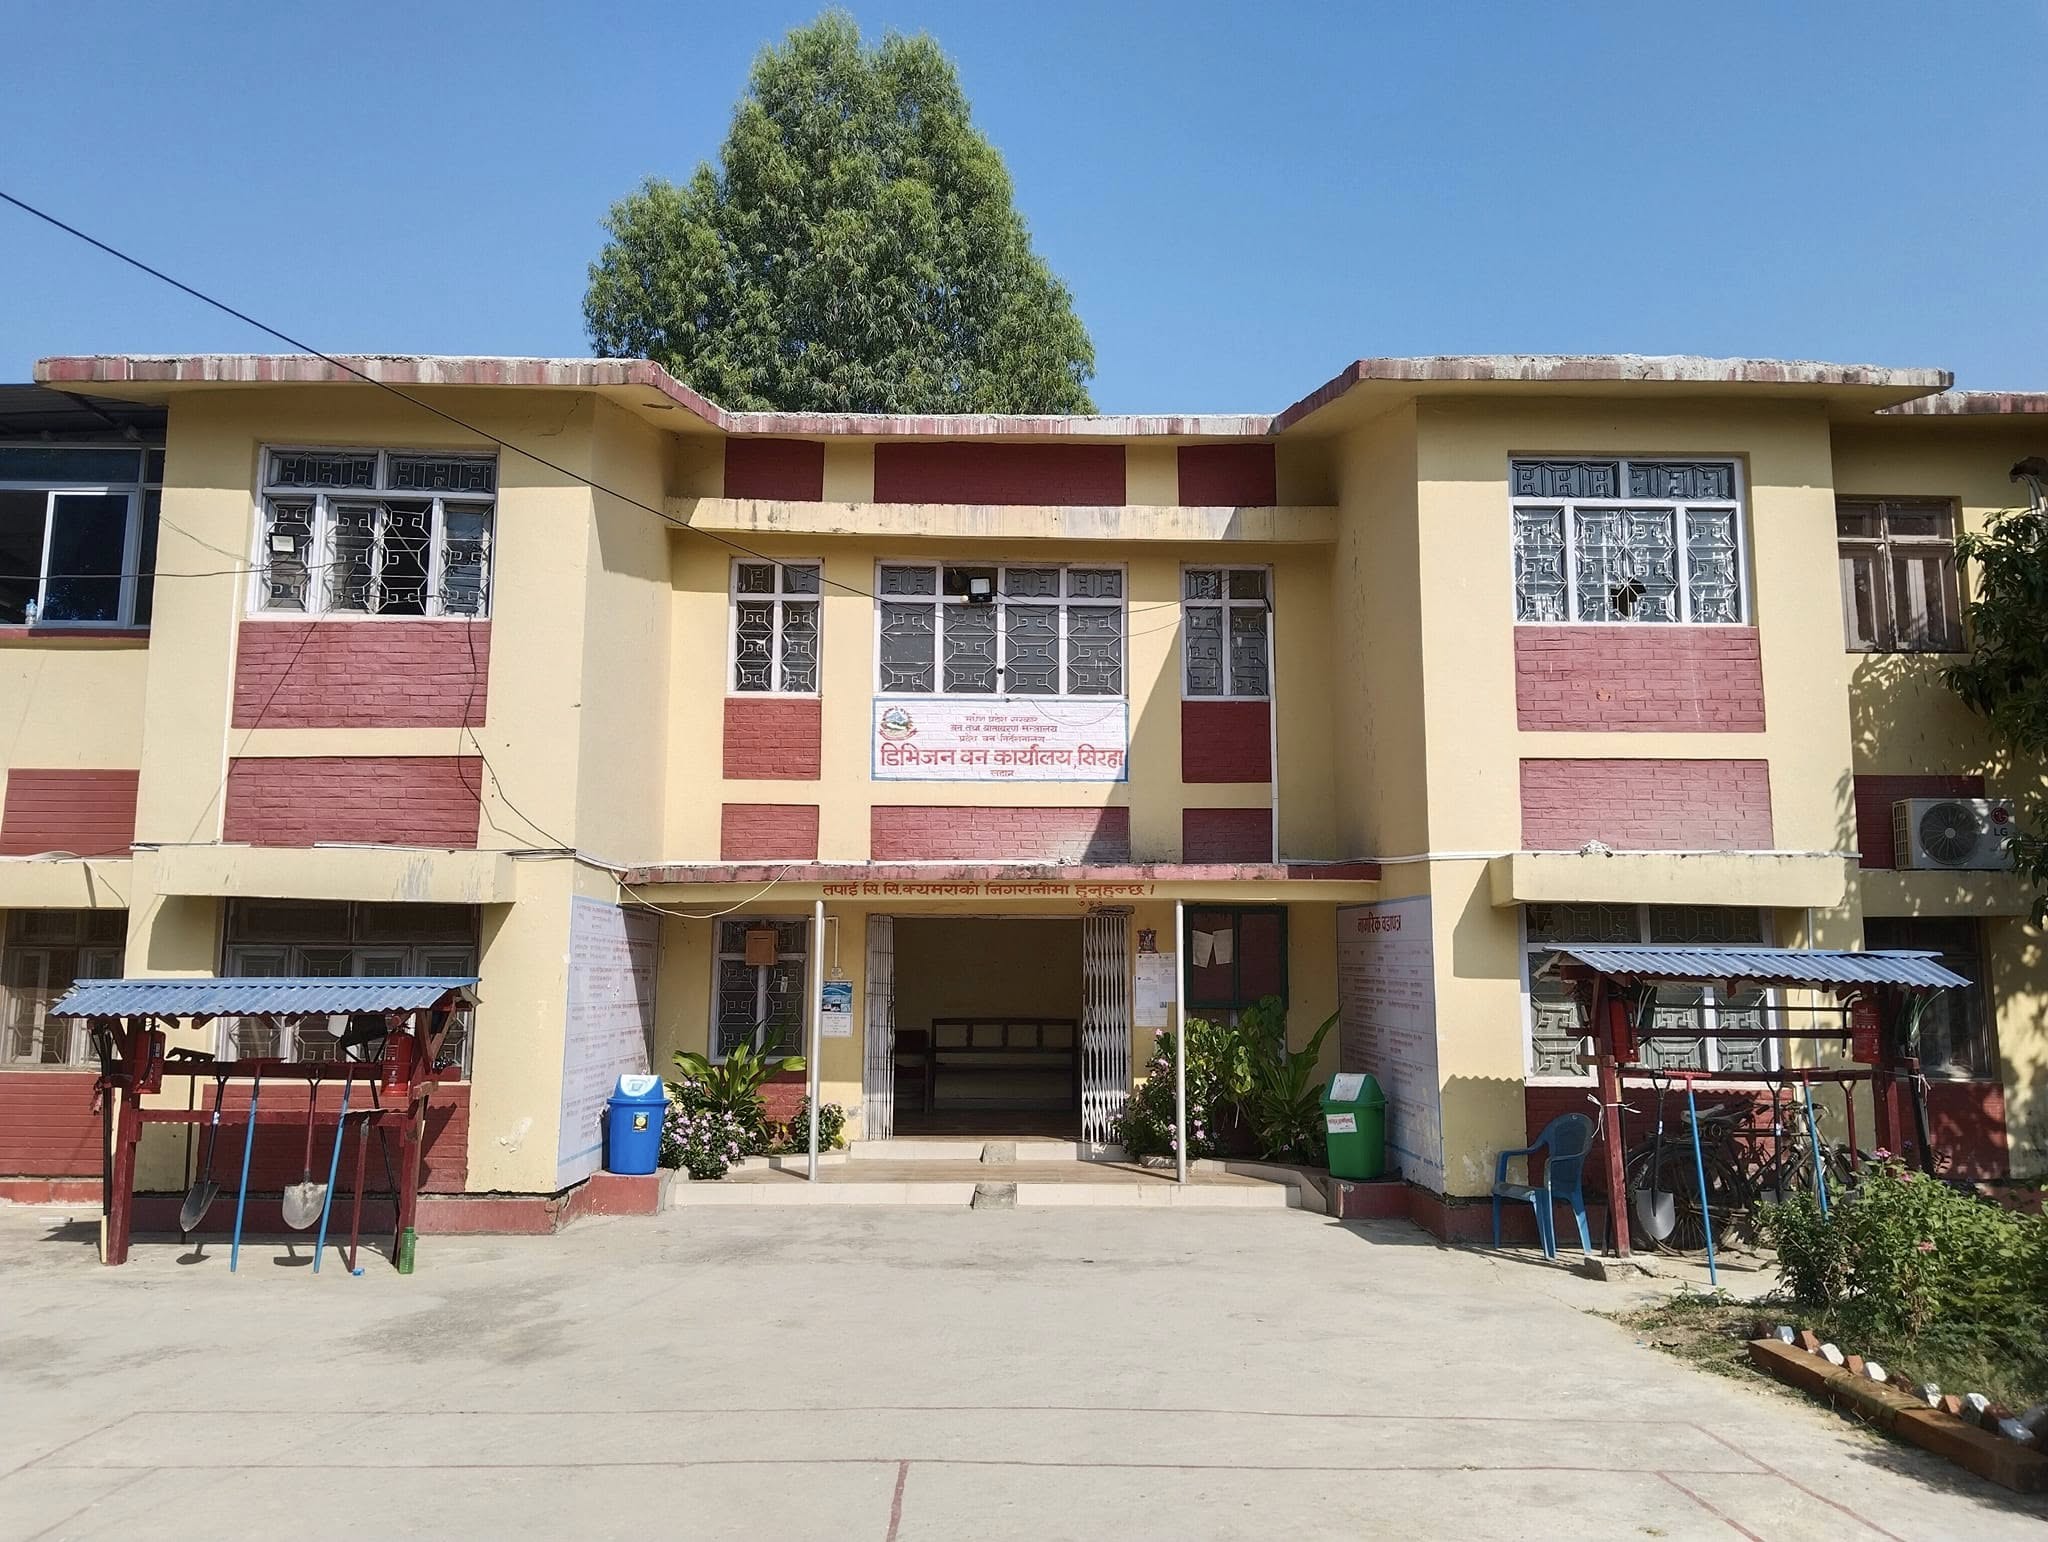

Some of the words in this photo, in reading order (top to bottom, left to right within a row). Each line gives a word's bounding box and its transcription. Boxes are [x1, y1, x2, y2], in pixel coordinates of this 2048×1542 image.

[988, 713, 1007, 723] प्रदेश
[950, 724, 962, 732] वन
[965, 724, 981, 732] तथा
[982, 724, 1019, 732] वातावरण
[1022, 724, 1058, 732] मन्त्रालय
[959, 733, 978, 743] प्रदेश
[880, 742, 957, 766] डिभिजन
[960, 749, 990, 765] वन
[1078, 743, 1124, 768] सिरहा
[1993, 827, 2008, 837] LG
[822, 881, 858, 896] तपाई
[984, 880, 1070, 896] निगरानीमा
